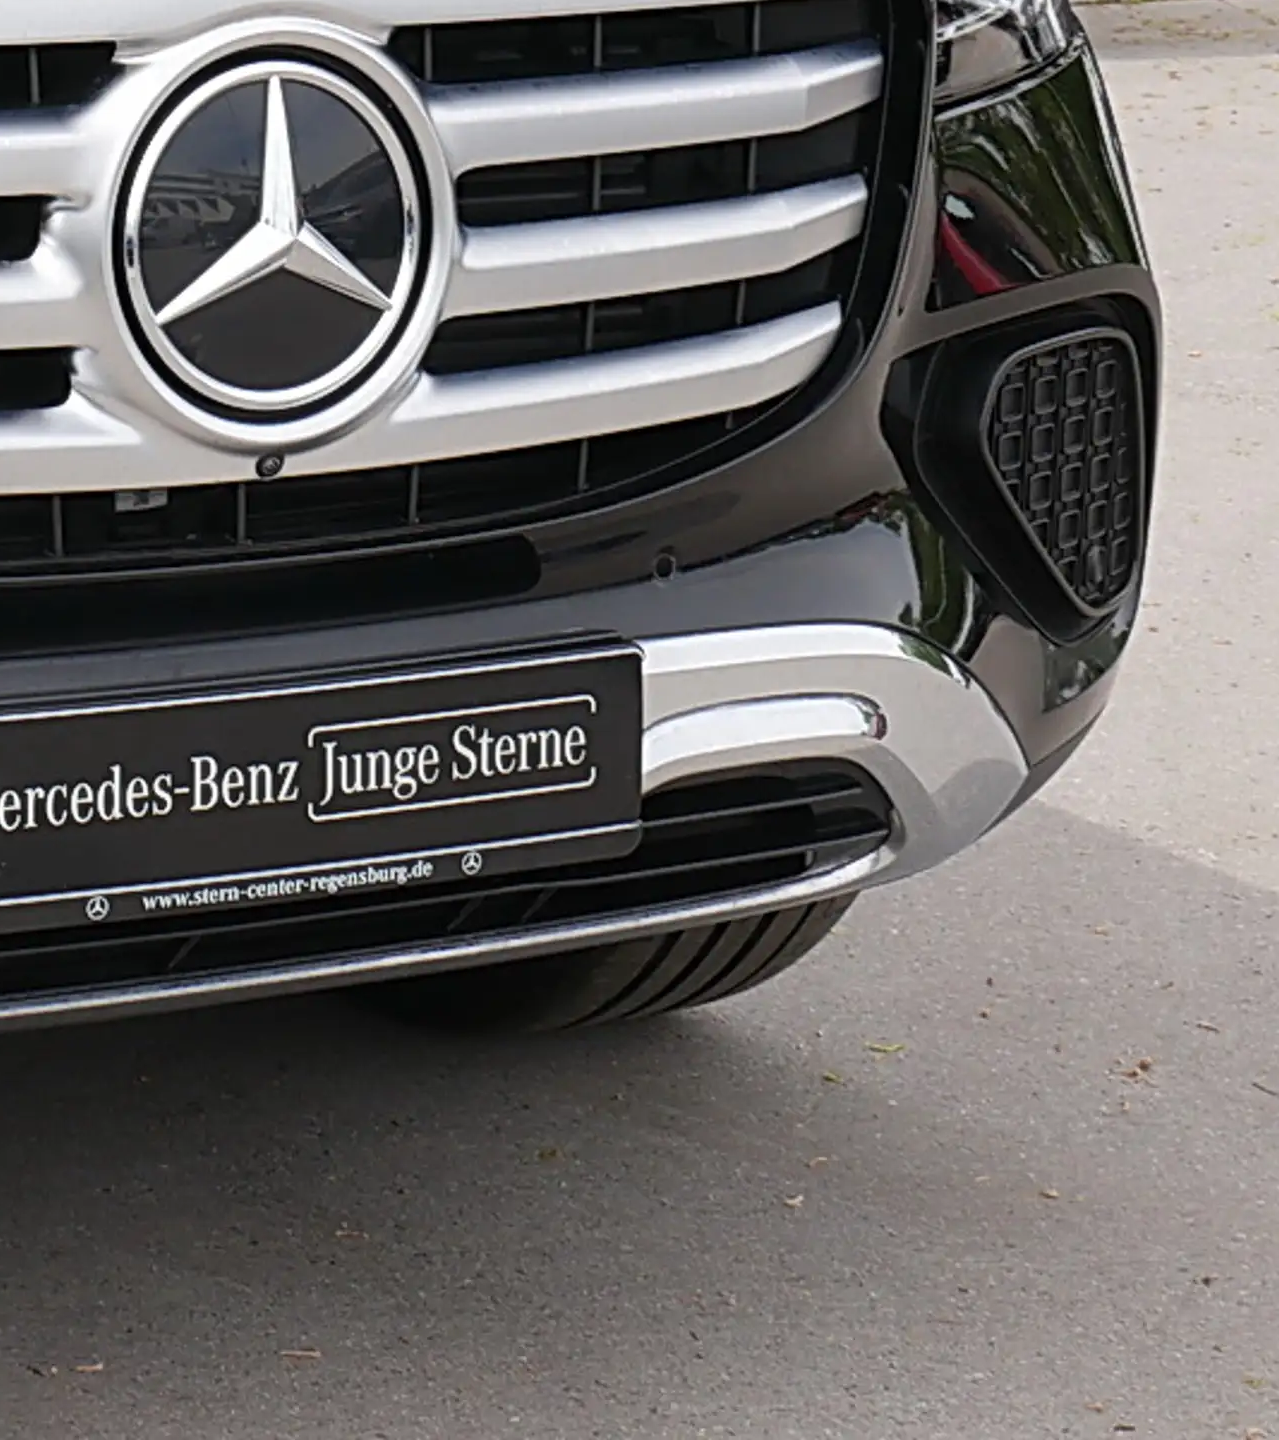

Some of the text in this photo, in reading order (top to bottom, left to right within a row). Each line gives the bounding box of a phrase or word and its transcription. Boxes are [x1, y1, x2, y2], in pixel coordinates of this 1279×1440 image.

[320, 741, 440, 806] Junge
[452, 724, 587, 781] Sterne
[142, 859, 434, 910] www.stern-center-regensburg.de
